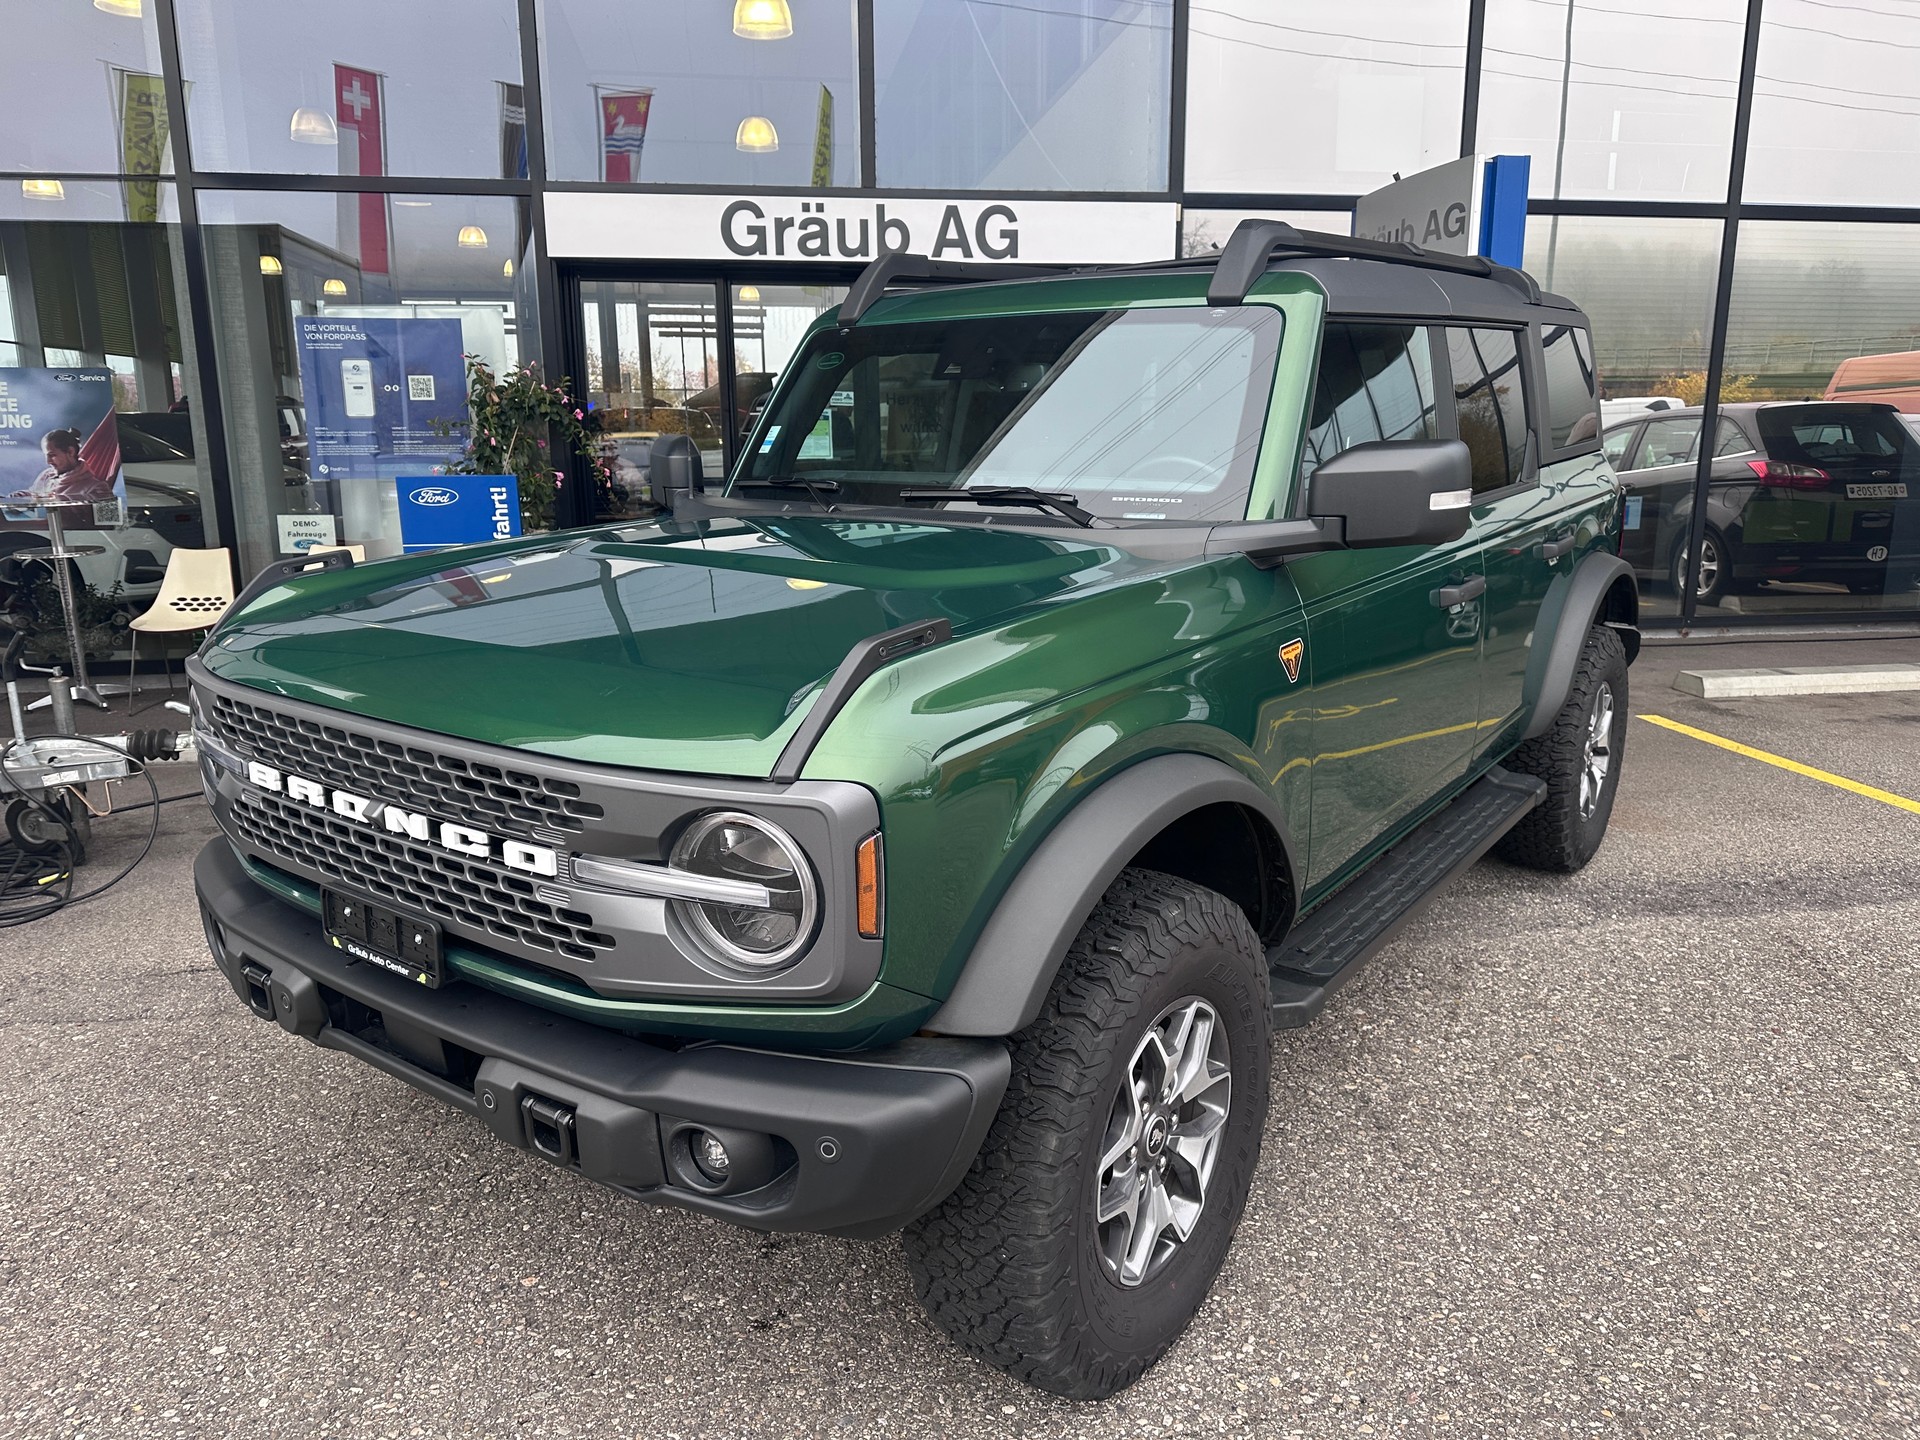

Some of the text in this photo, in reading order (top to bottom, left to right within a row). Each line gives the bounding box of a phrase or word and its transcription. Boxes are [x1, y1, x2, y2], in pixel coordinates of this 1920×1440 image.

[720, 199, 1019, 260] Gräub AG
[1421, 202, 1466, 245] AG
[304, 324, 357, 332] DIE VORTEILE
[305, 333, 367, 341] VON FORDPASS
[79, 374, 106, 382] Service
[417, 489, 452, 504] Ford
[490, 487, 511, 540] fahrt!
[287, 531, 327, 539] Fahrzeuge
[248, 761, 558, 877] BRONCO
[347, 943, 410, 976] Gräub Auto Center
